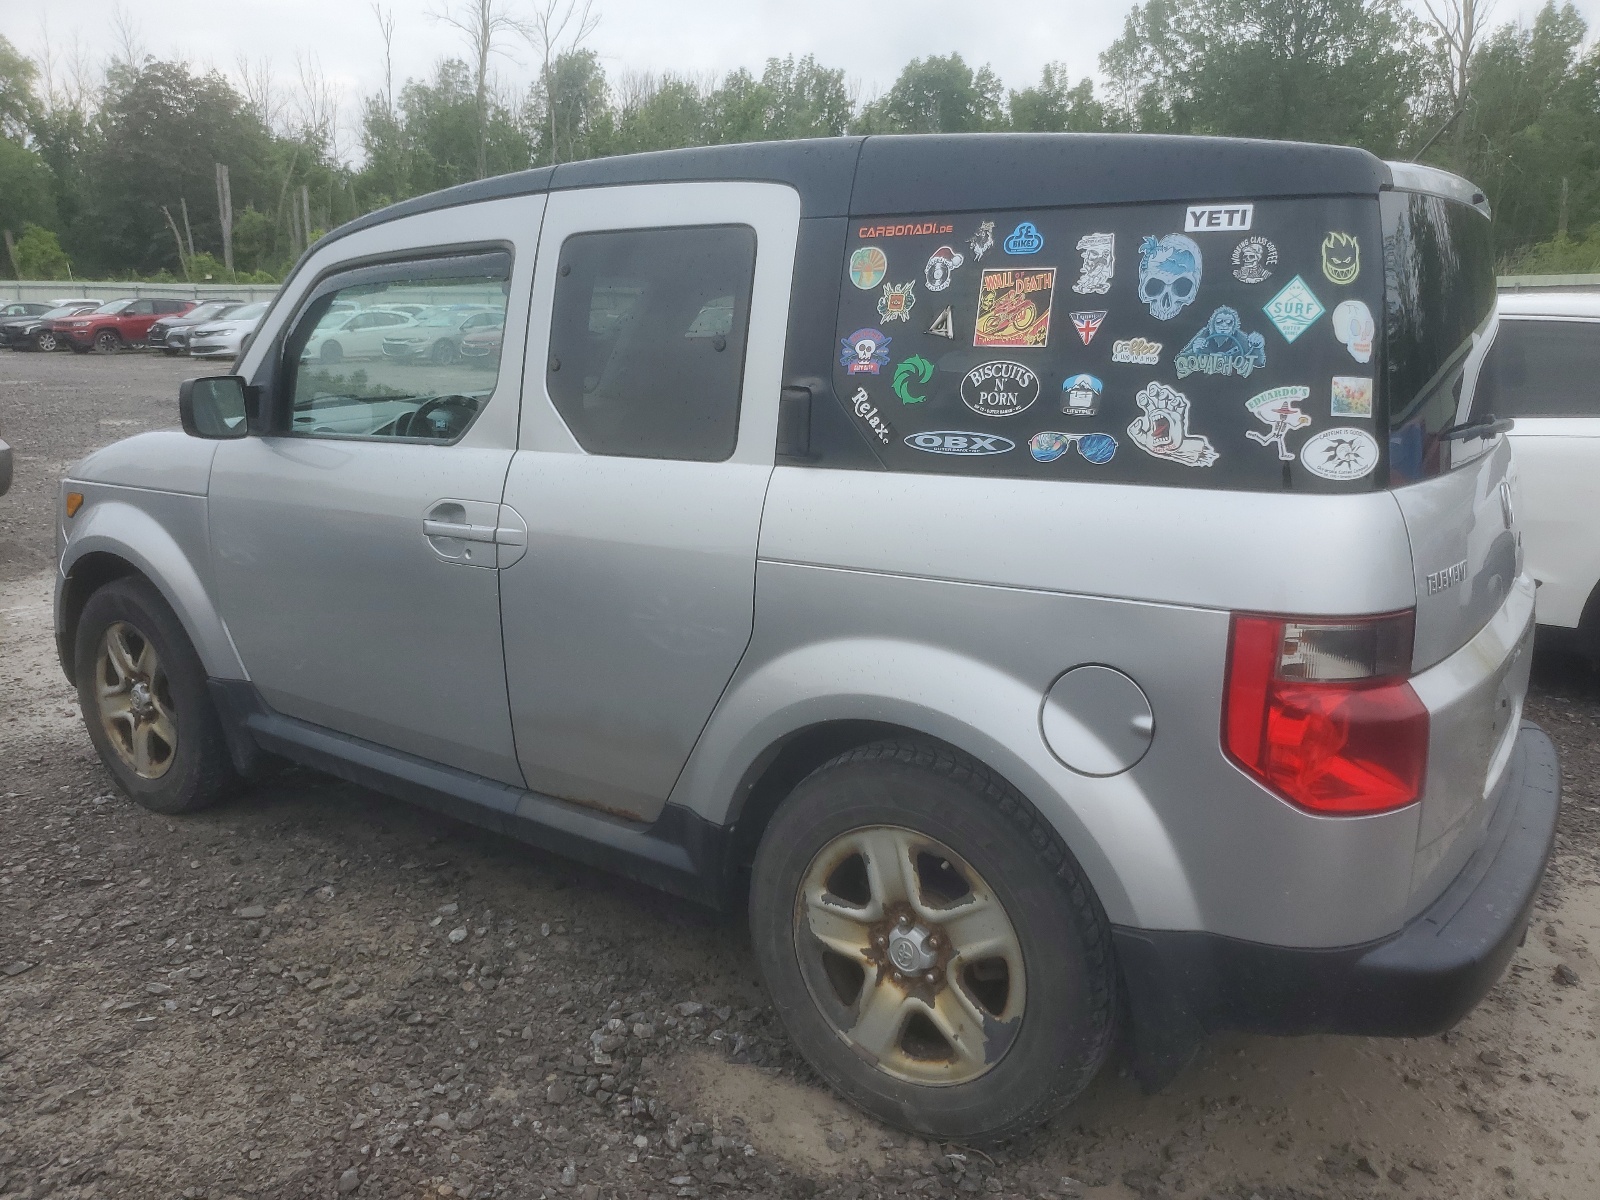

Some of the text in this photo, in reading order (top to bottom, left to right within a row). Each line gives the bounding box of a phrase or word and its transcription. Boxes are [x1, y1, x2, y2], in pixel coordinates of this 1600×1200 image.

[1189, 209, 1248, 228] YETI
[1014, 225, 1034, 240] SE
[1012, 240, 1034, 248] BIKES
[983, 271, 1025, 291] WALL OF
[1015, 272, 1052, 295] DEATH
[1273, 302, 1314, 315] SURF
[969, 364, 1034, 388] BISCUITS
[979, 391, 1019, 406] PORN
[914, 435, 997, 451] OBX
